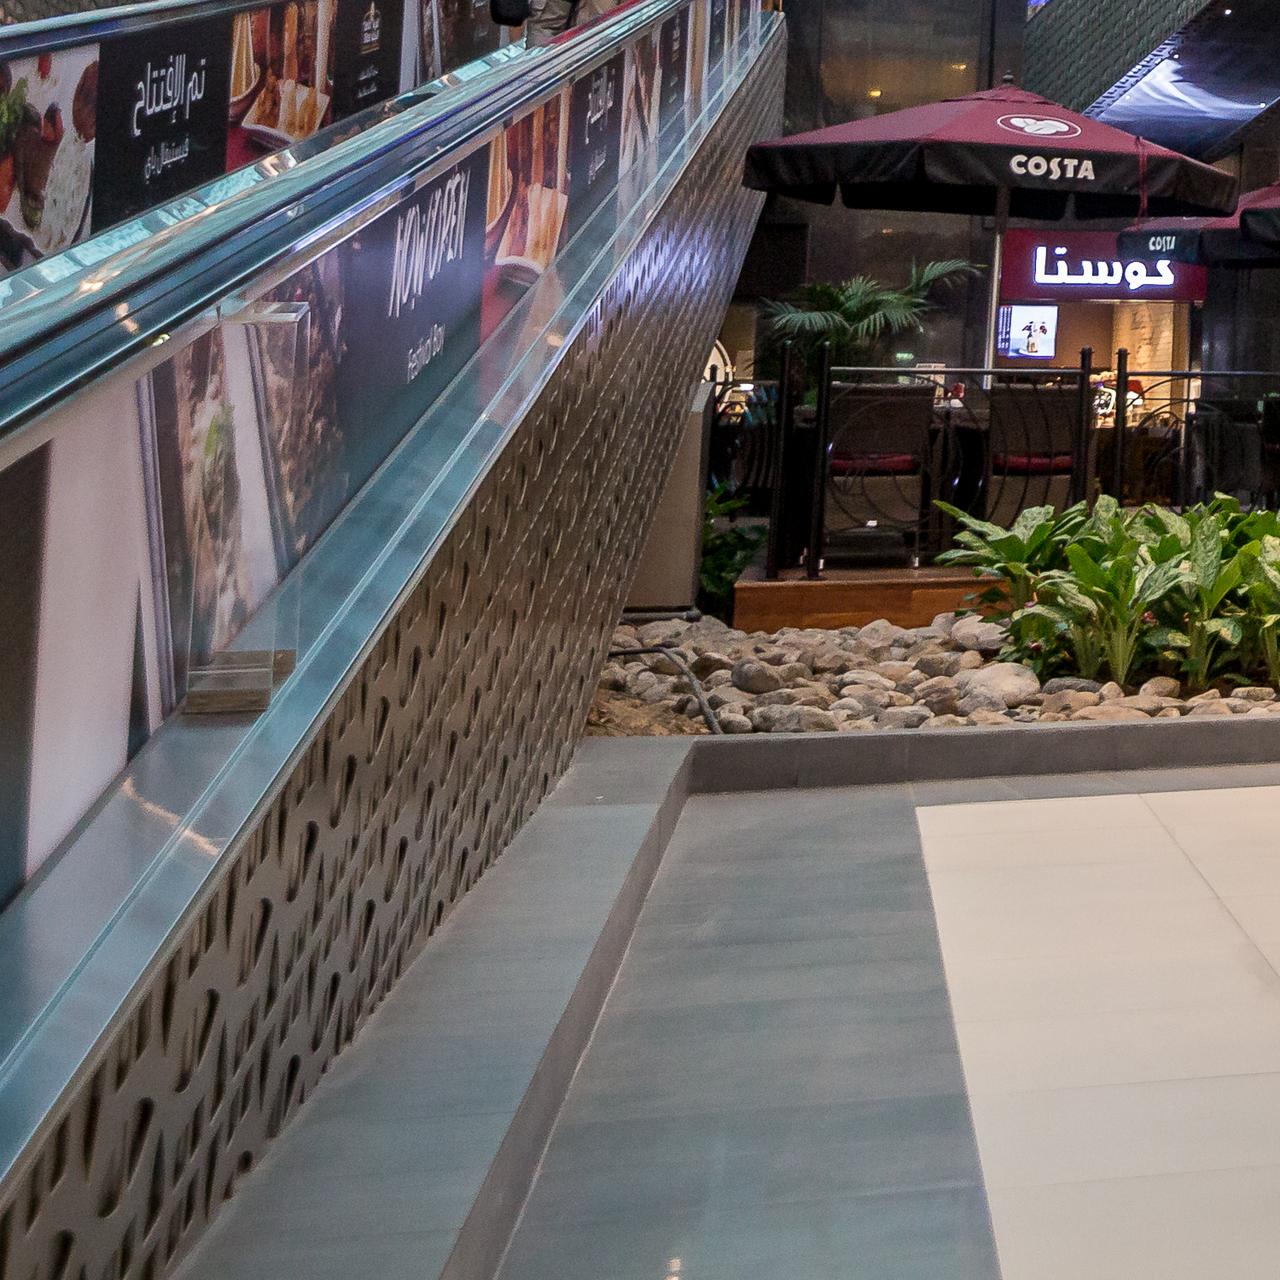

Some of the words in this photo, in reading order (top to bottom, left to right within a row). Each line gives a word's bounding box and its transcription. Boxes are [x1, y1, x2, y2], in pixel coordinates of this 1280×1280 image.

[185, 58, 206, 120] تم
[1009, 154, 1095, 180] COSTA
[1149, 236, 1176, 252] COSTA
[1034, 246, 1175, 290] كوستا
